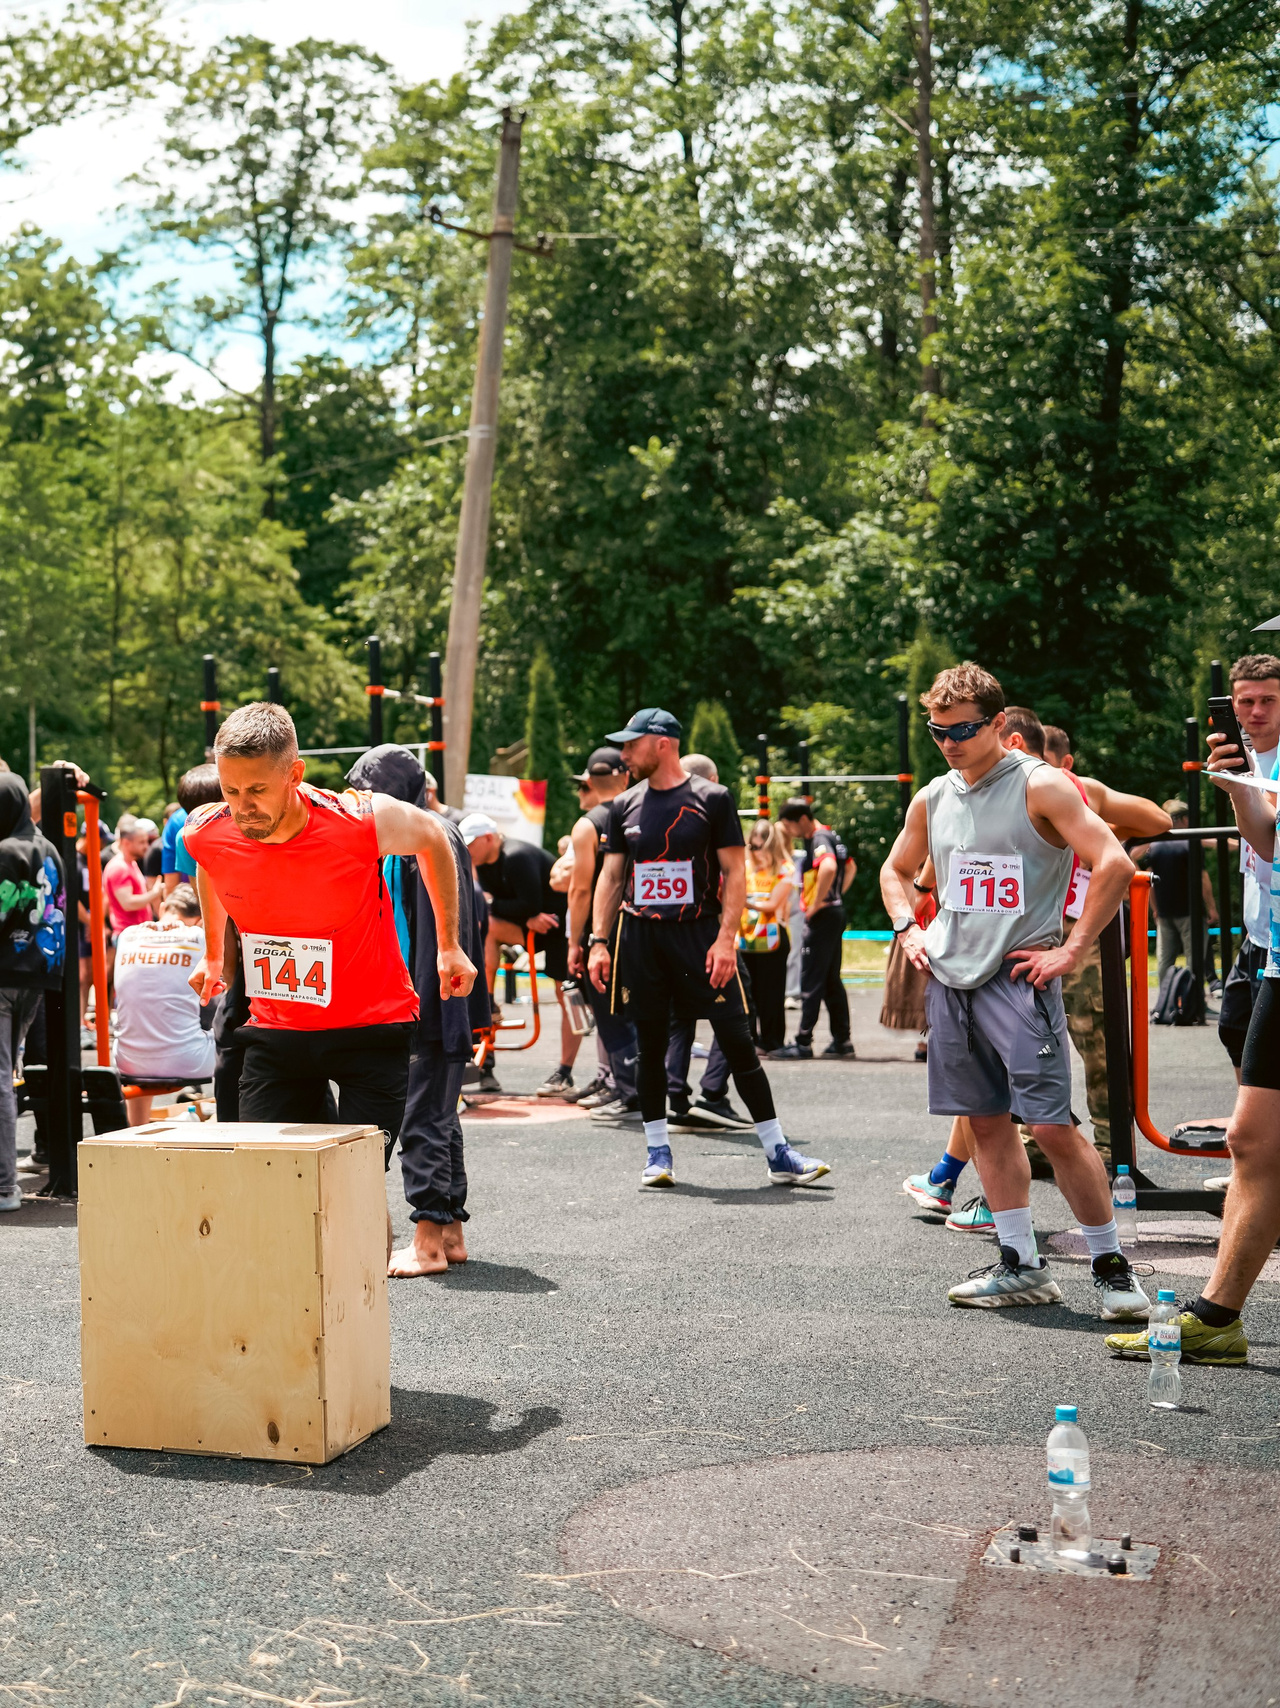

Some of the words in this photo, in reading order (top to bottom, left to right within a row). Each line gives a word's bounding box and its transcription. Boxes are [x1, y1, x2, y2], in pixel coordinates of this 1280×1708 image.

[959, 868, 994, 876] BOGAL
[641, 877, 688, 900] 259
[960, 876, 1020, 908] 113
[121, 952, 192, 967] БИЧЕНОВ
[253, 947, 296, 958] BOGAL
[253, 957, 326, 996] 144
